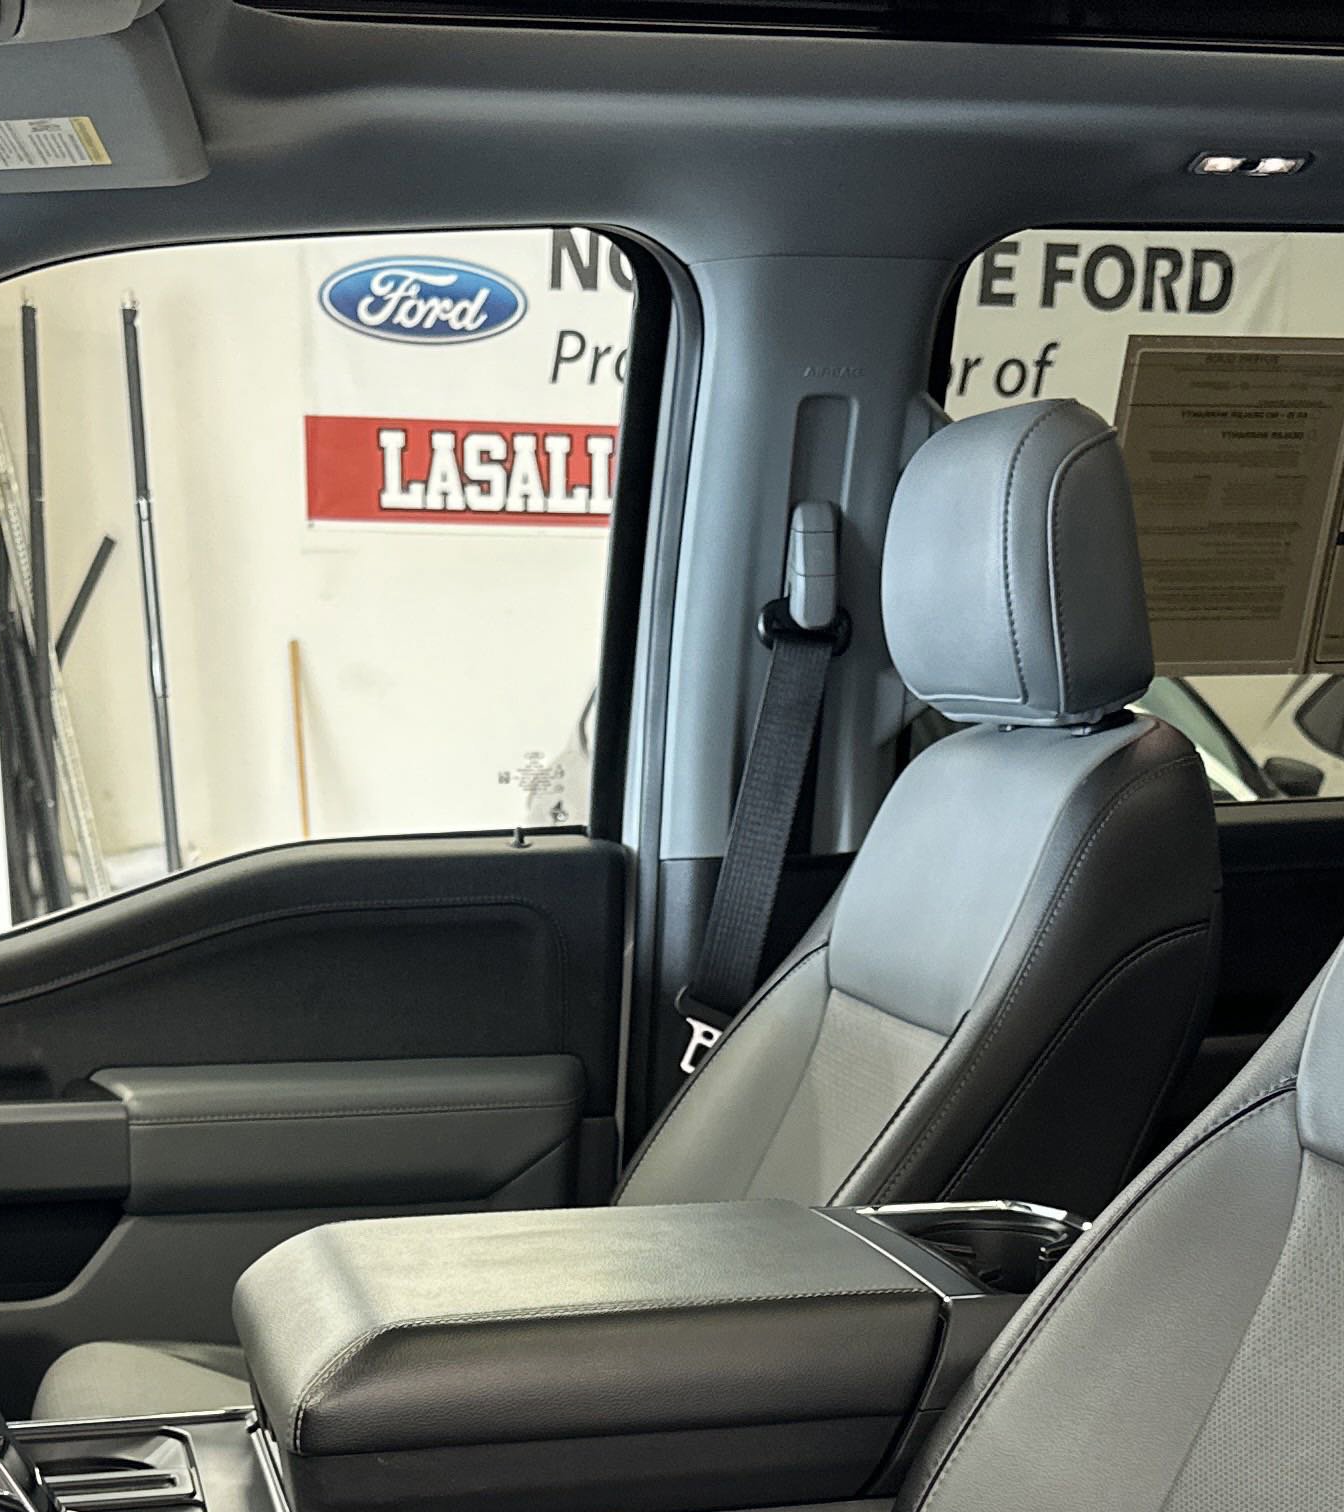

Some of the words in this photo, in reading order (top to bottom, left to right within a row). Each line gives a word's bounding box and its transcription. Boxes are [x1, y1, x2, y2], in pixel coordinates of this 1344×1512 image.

[357, 268, 489, 332] Ford
[1040, 242, 1233, 313] FORD
[993, 342, 1060, 398] of
